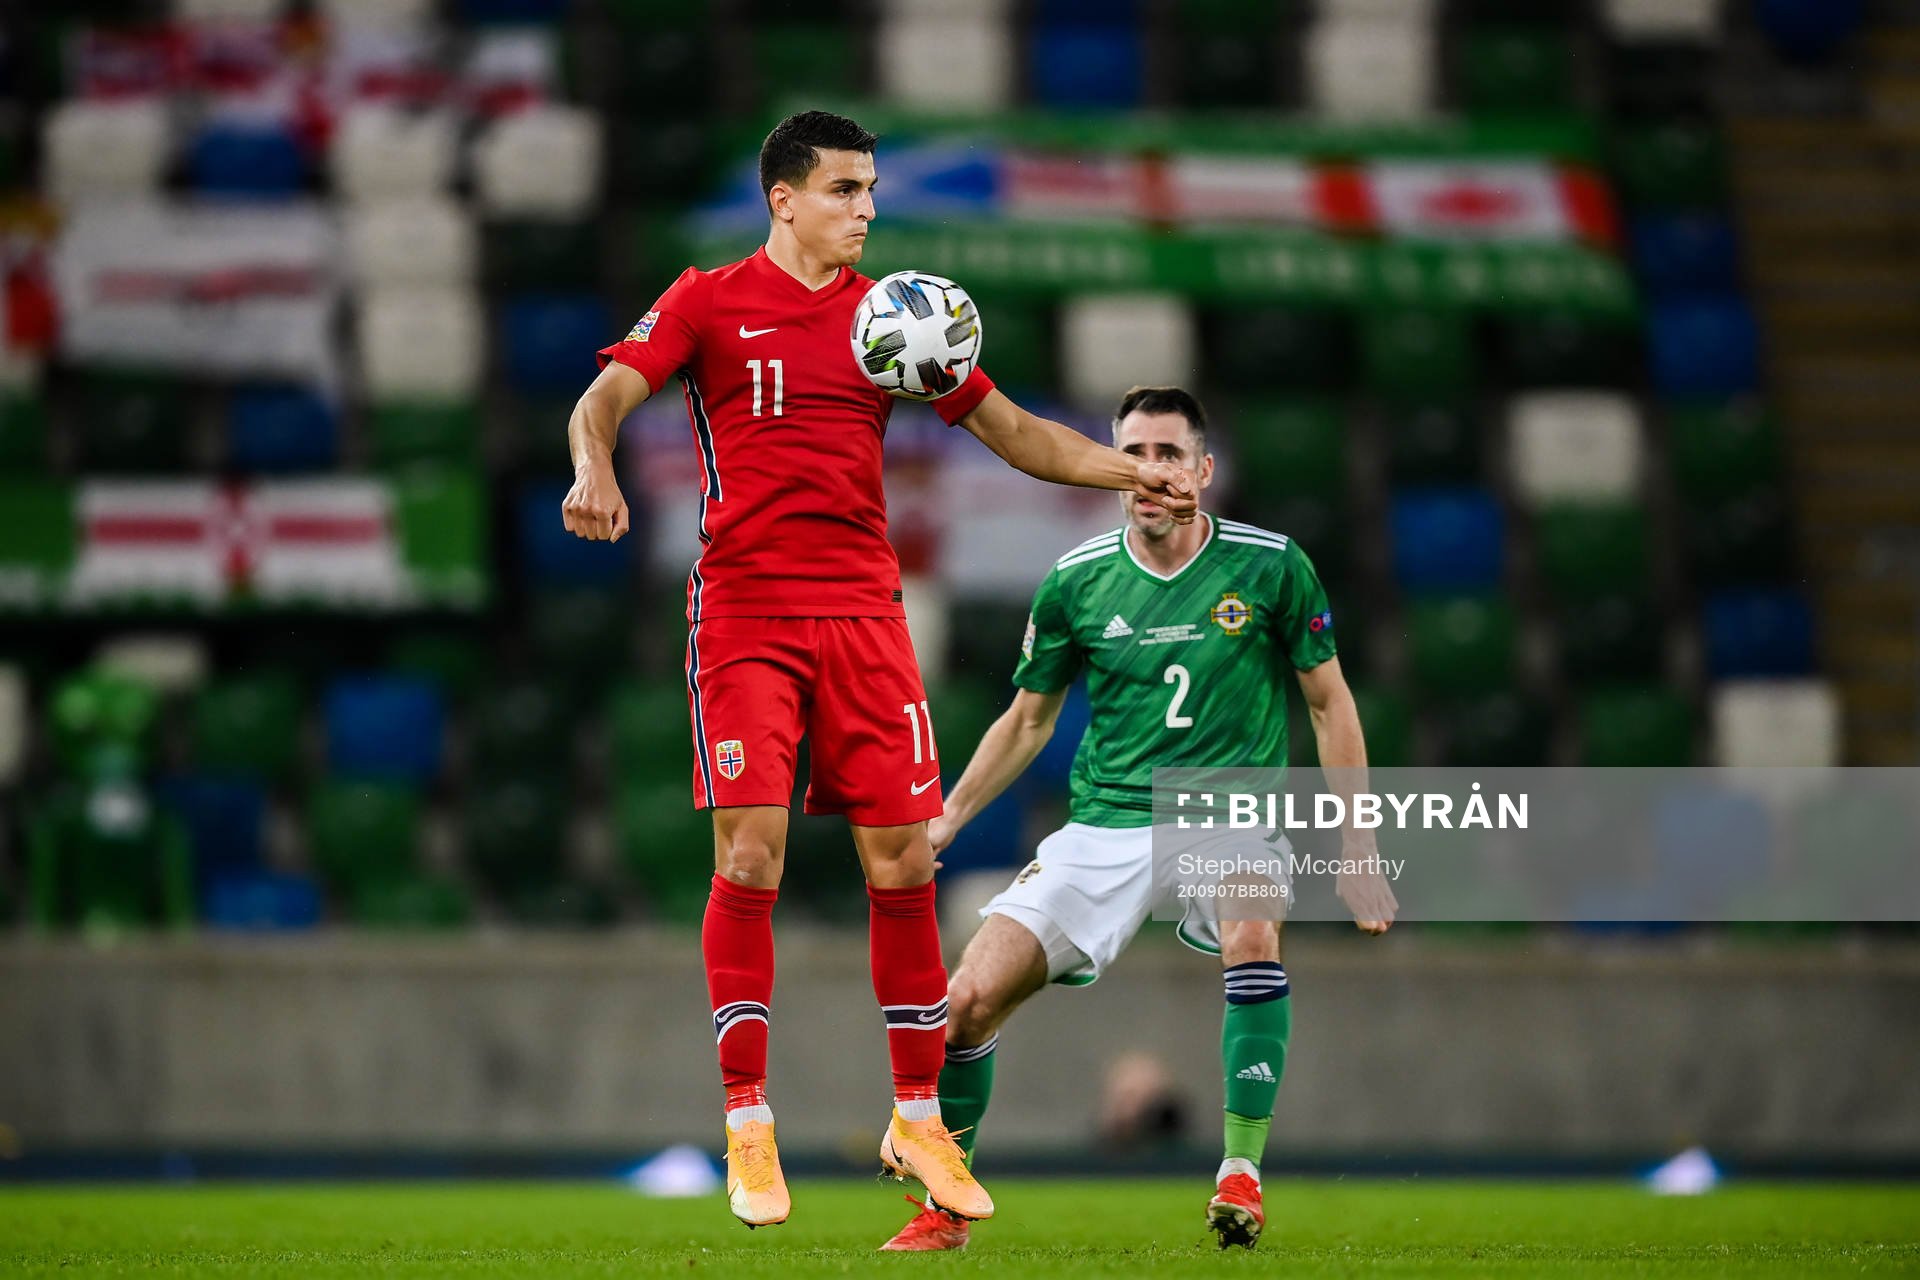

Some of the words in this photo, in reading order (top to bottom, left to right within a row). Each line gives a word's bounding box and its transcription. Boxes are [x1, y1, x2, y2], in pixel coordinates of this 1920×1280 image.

[745, 359, 783, 416] 11
[1163, 663, 1193, 728] 2
[903, 700, 936, 764] 11
